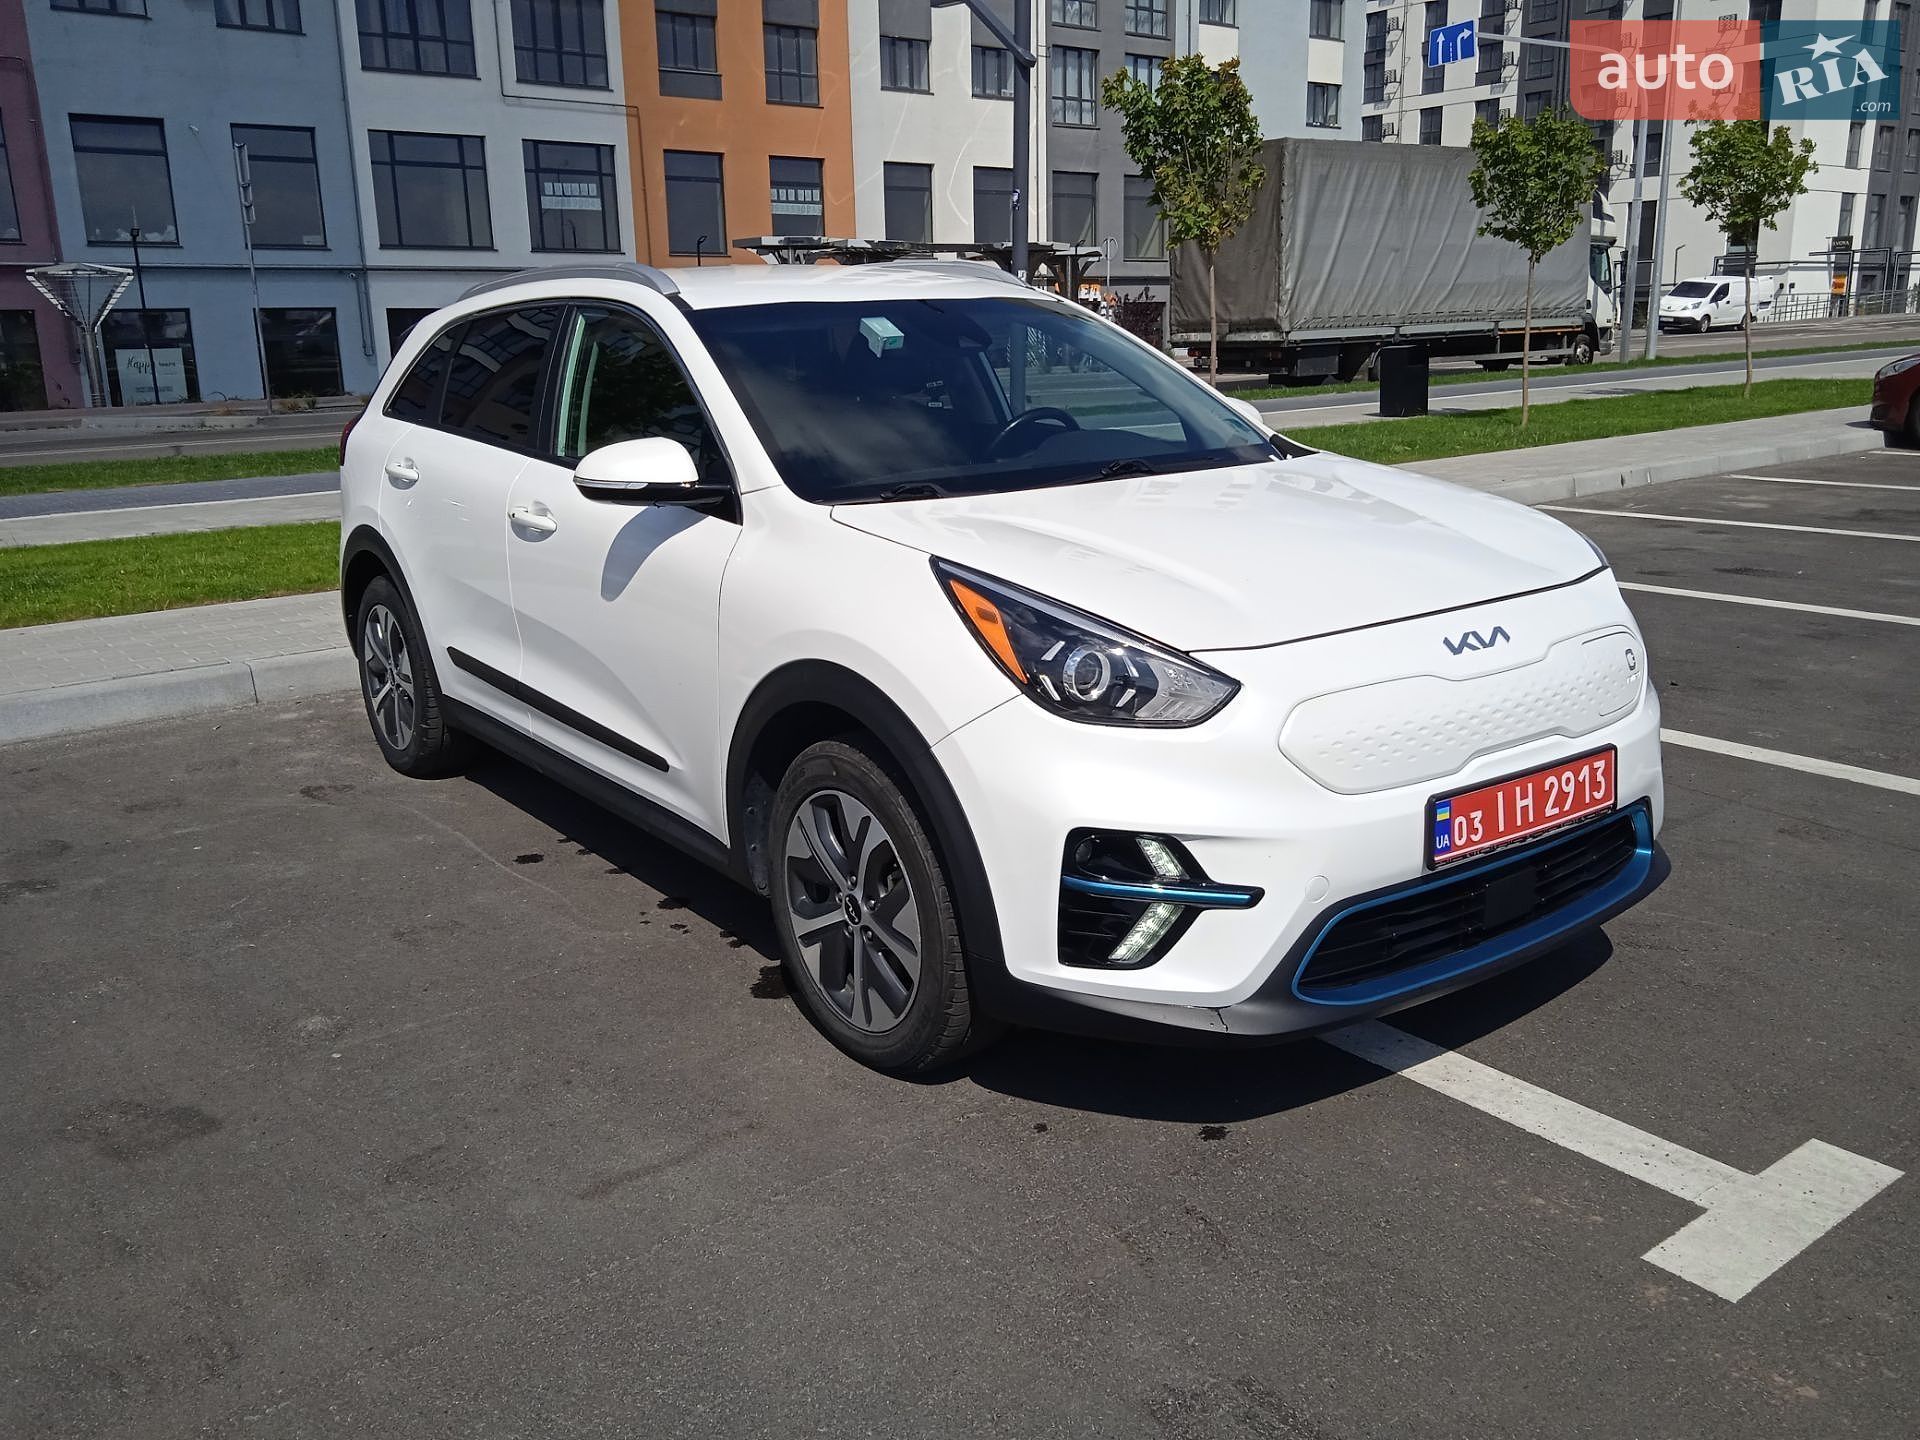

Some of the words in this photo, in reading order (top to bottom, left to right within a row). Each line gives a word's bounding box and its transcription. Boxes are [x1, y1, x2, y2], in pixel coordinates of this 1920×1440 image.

[126, 355, 153, 375] Happ
[1443, 626, 1510, 655] KIA
[1454, 810, 1483, 846] 03
[1544, 760, 1606, 818] 2913
[1435, 834, 1450, 849] UA
